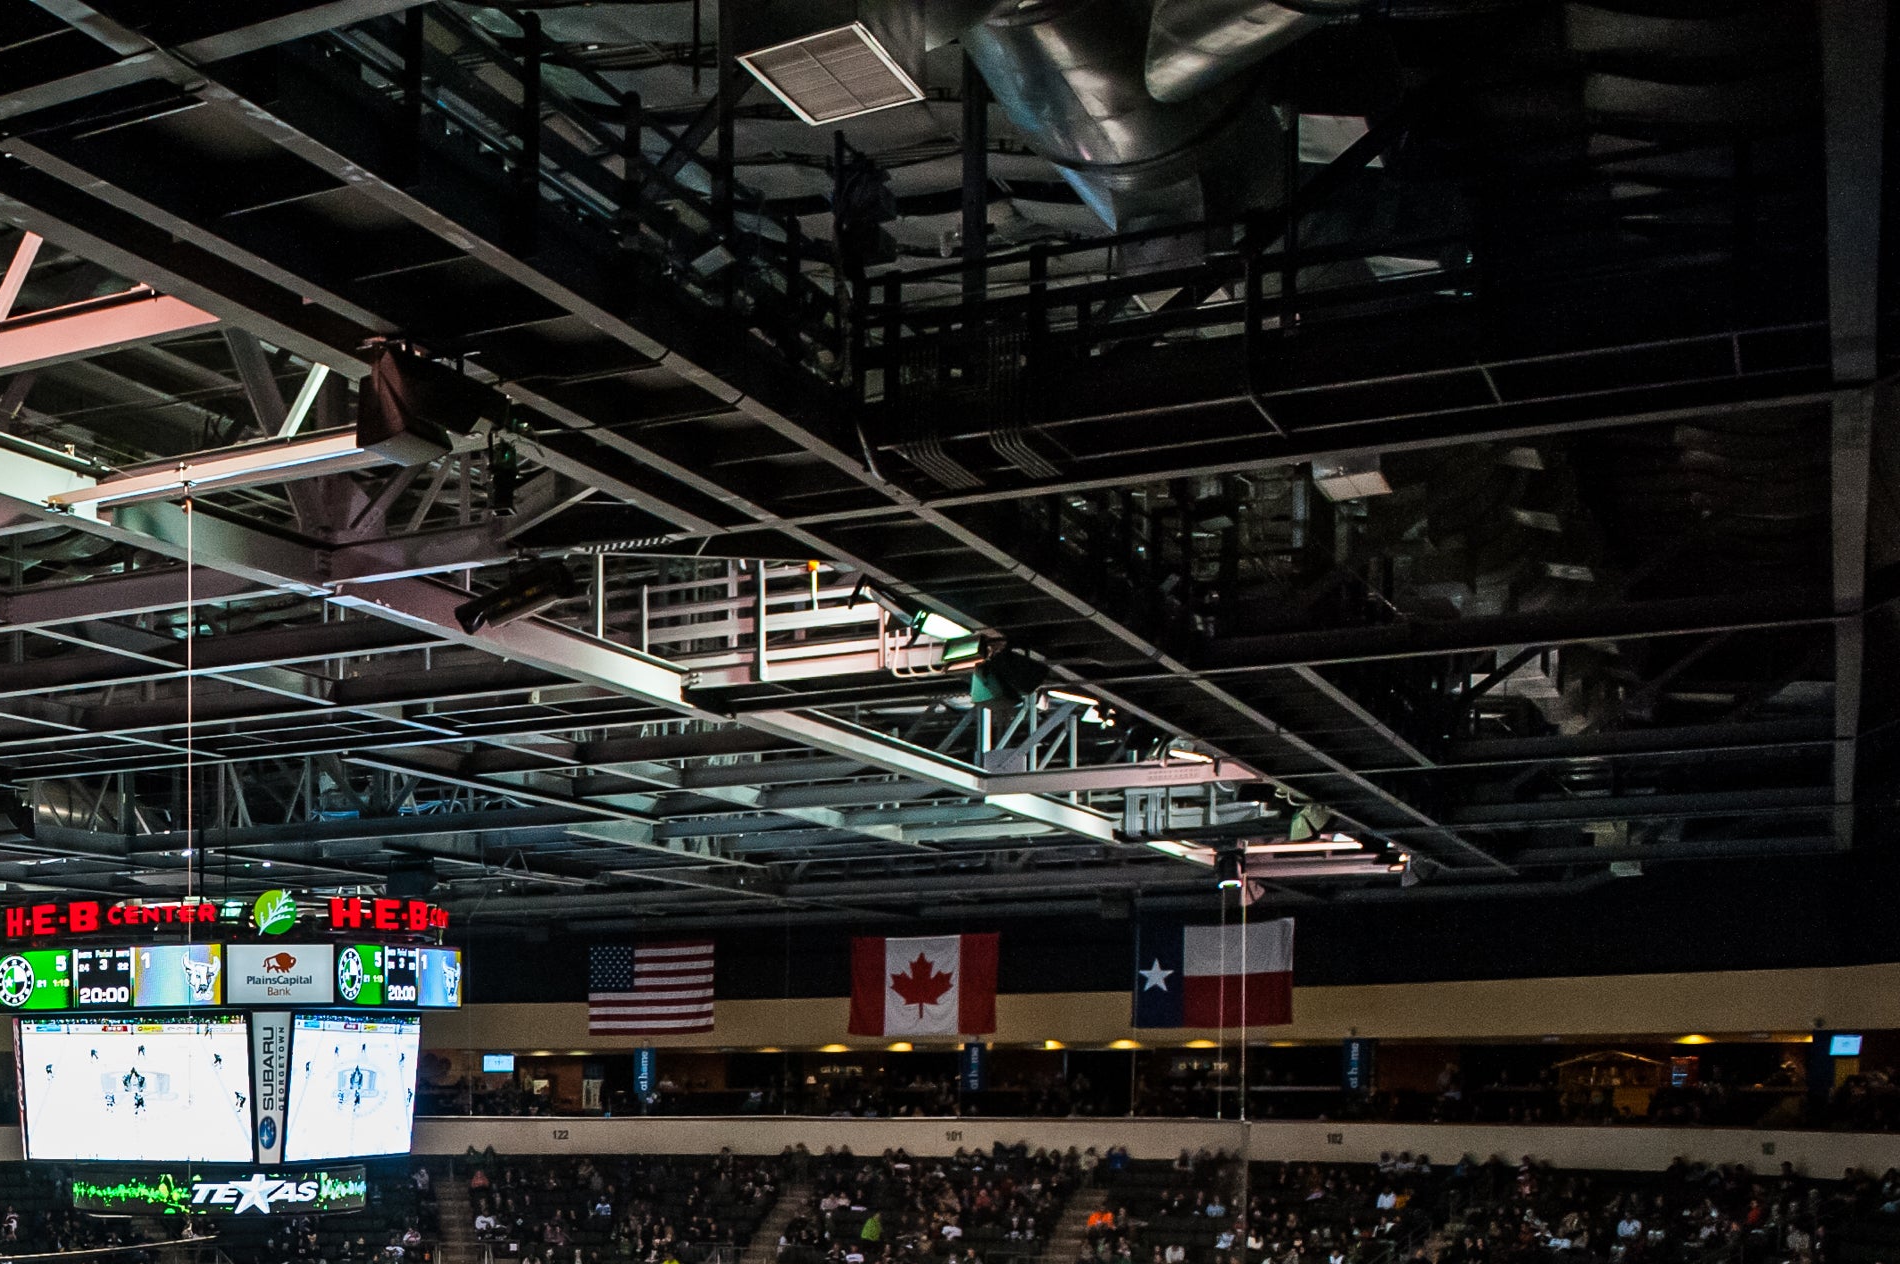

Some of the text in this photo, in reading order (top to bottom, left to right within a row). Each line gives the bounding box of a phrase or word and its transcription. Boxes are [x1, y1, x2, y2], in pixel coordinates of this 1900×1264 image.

[107, 904, 217, 924] CENTER
[55, 955, 67, 972] 5
[100, 959, 108, 971] 3
[140, 953, 151, 969] 1
[374, 952, 383, 968] 5
[399, 958, 405, 969] 3
[421, 954, 428, 970] 1
[246, 975, 313, 987] PlainsCapital
[80, 987, 130, 1004] 20:00
[267, 987, 292, 997] Bank
[388, 985, 416, 1001] 20:00
[262, 1026, 275, 1111] SUBARU
[639, 1076, 649, 1091] at
[552, 1129, 569, 1141] 122
[191, 1173, 320, 1214] TEXAS
